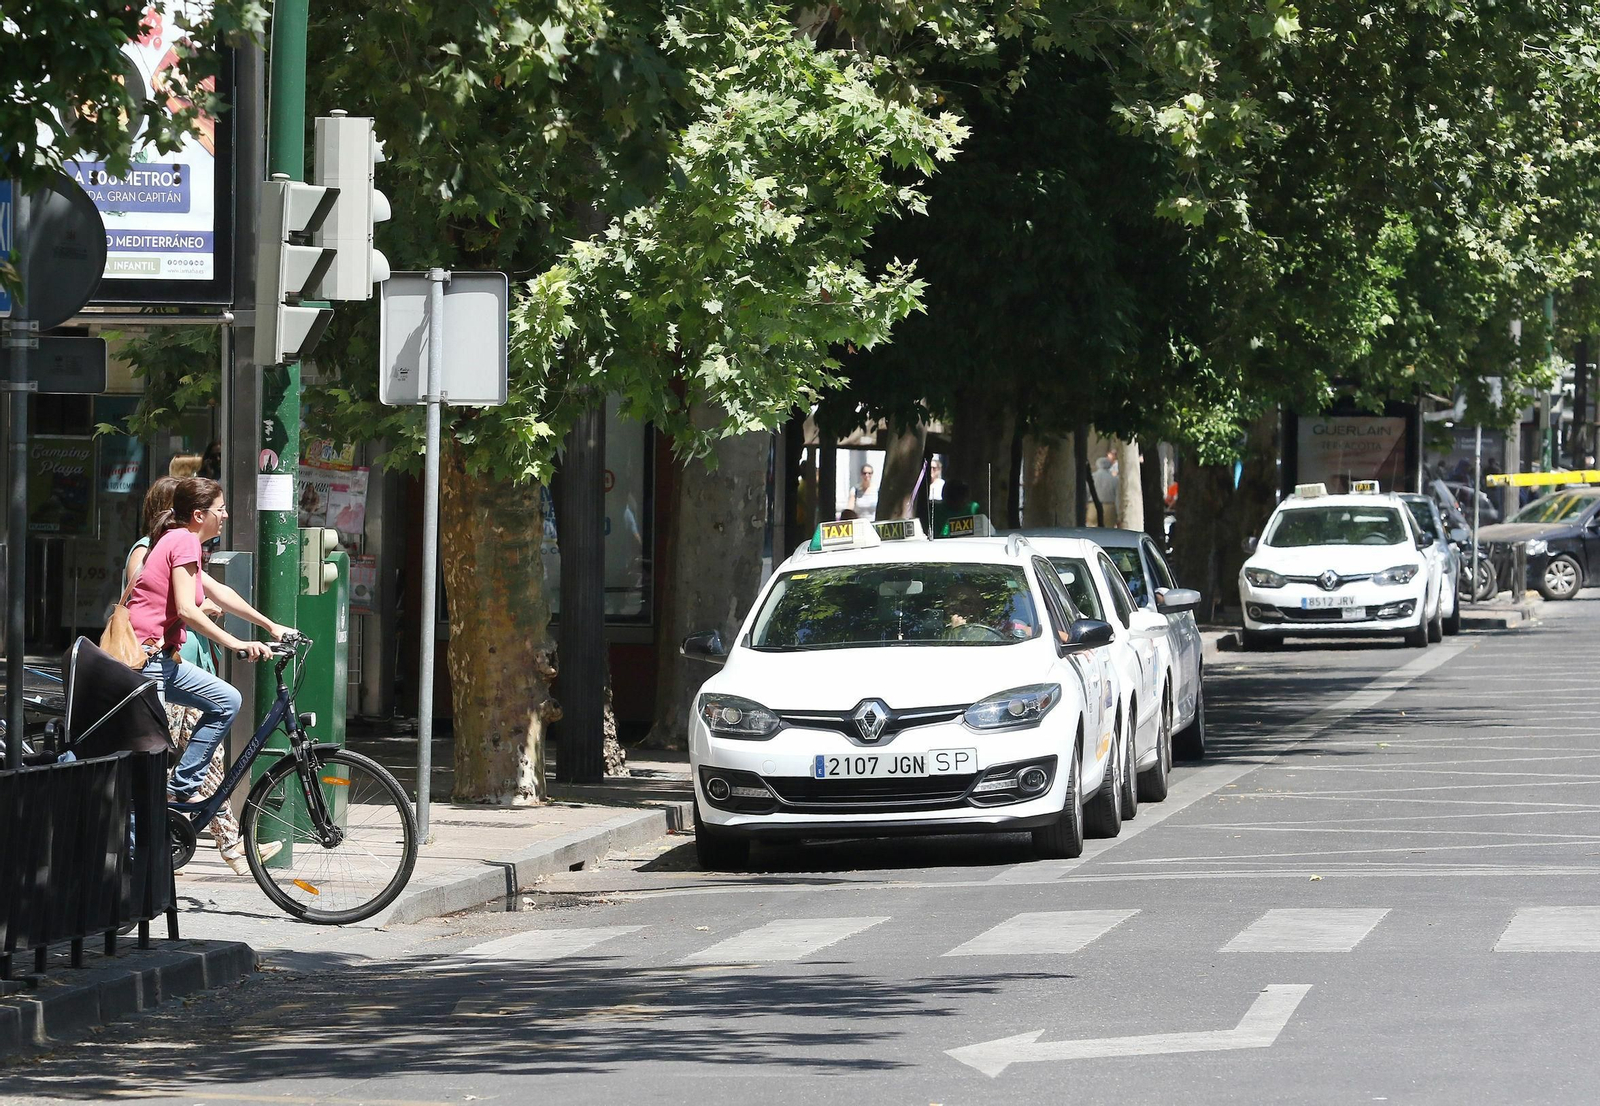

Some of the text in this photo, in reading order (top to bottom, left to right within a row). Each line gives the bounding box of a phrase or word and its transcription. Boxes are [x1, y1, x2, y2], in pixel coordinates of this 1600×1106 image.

[75, 170, 85, 185] A
[120, 171, 181, 187] METROS
[86, 189, 182, 203] DA. GRAN CAPITÁN
[115, 233, 204, 248] MEDITERRÁNEO
[113, 260, 156, 271] INFANTIL
[1313, 423, 1392, 436] GUERLAIN
[31, 443, 92, 461] Camping
[36, 460, 86, 477] Playa
[822, 524, 853, 539] TAXI
[878, 521, 903, 538] TAXI
[950, 520, 974, 532] TAXI
[1308, 596, 1356, 607] 8512 JRV
[828, 756, 879, 776] 2107
[887, 755, 925, 775] JGN
[936, 752, 970, 772] SP
